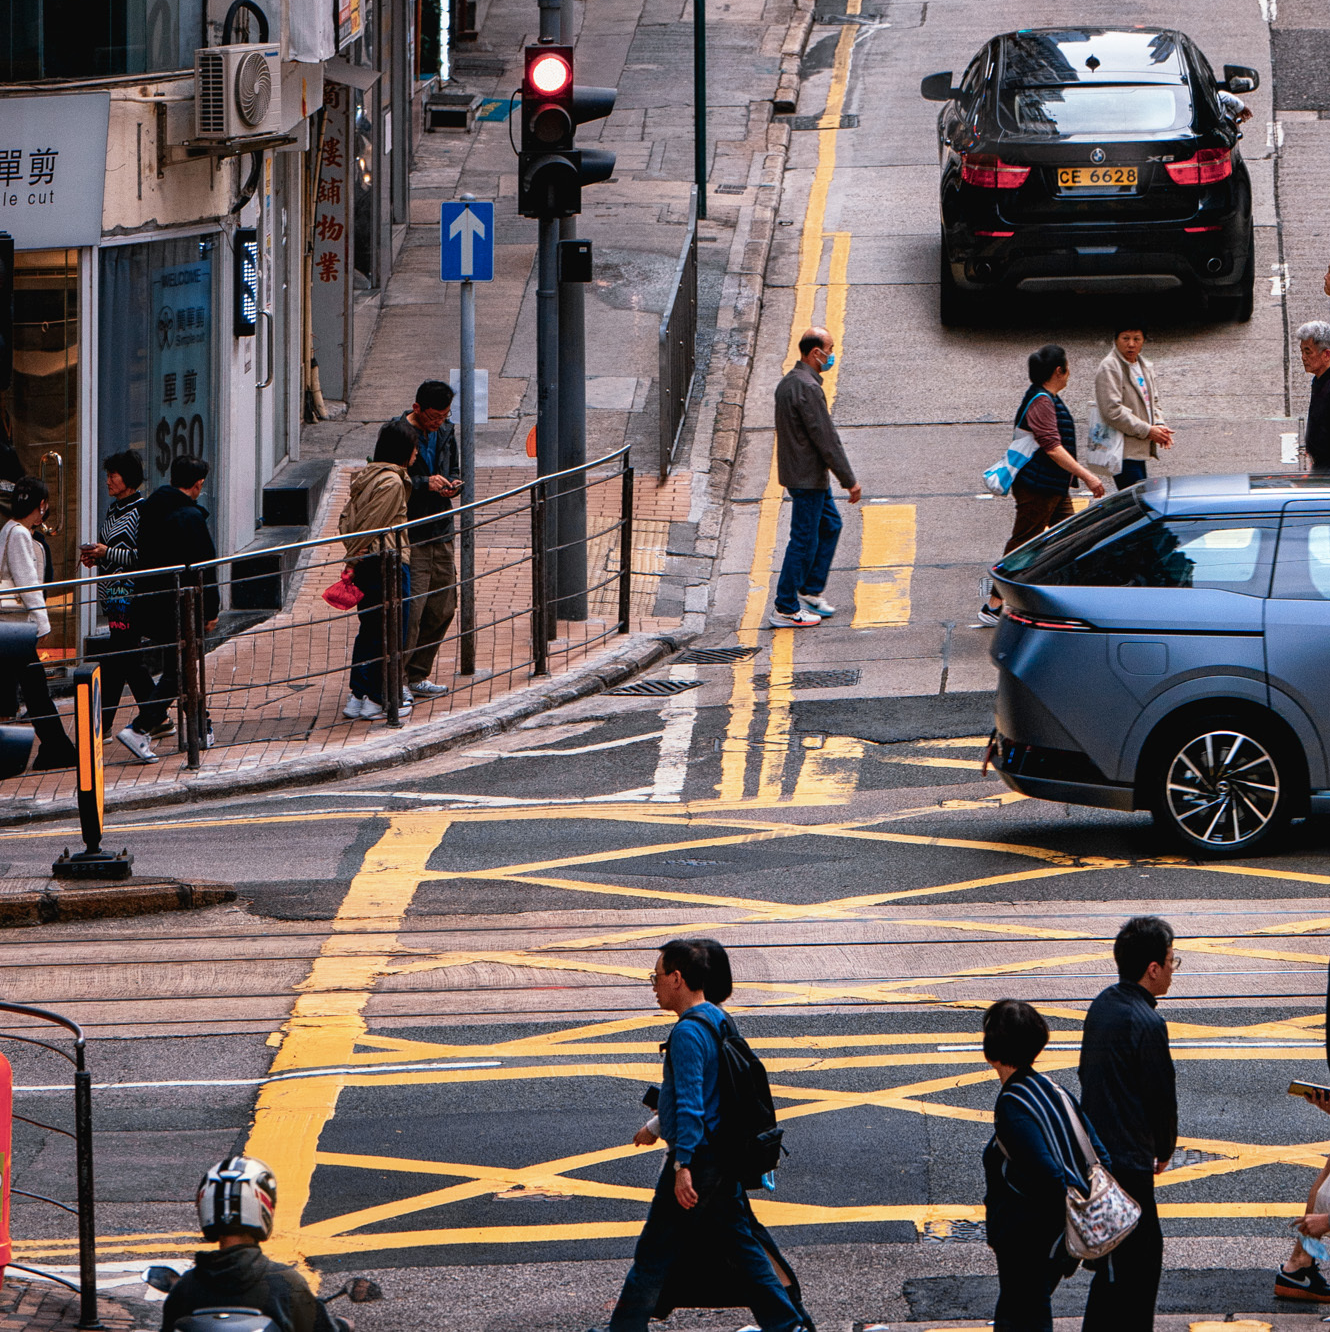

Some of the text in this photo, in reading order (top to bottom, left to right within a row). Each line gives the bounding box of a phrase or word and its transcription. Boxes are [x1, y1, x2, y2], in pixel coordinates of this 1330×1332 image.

[1146, 155, 1175, 163] X6
[1060, 168, 1137, 185] CE 6628
[28, 189, 54, 205] cut
